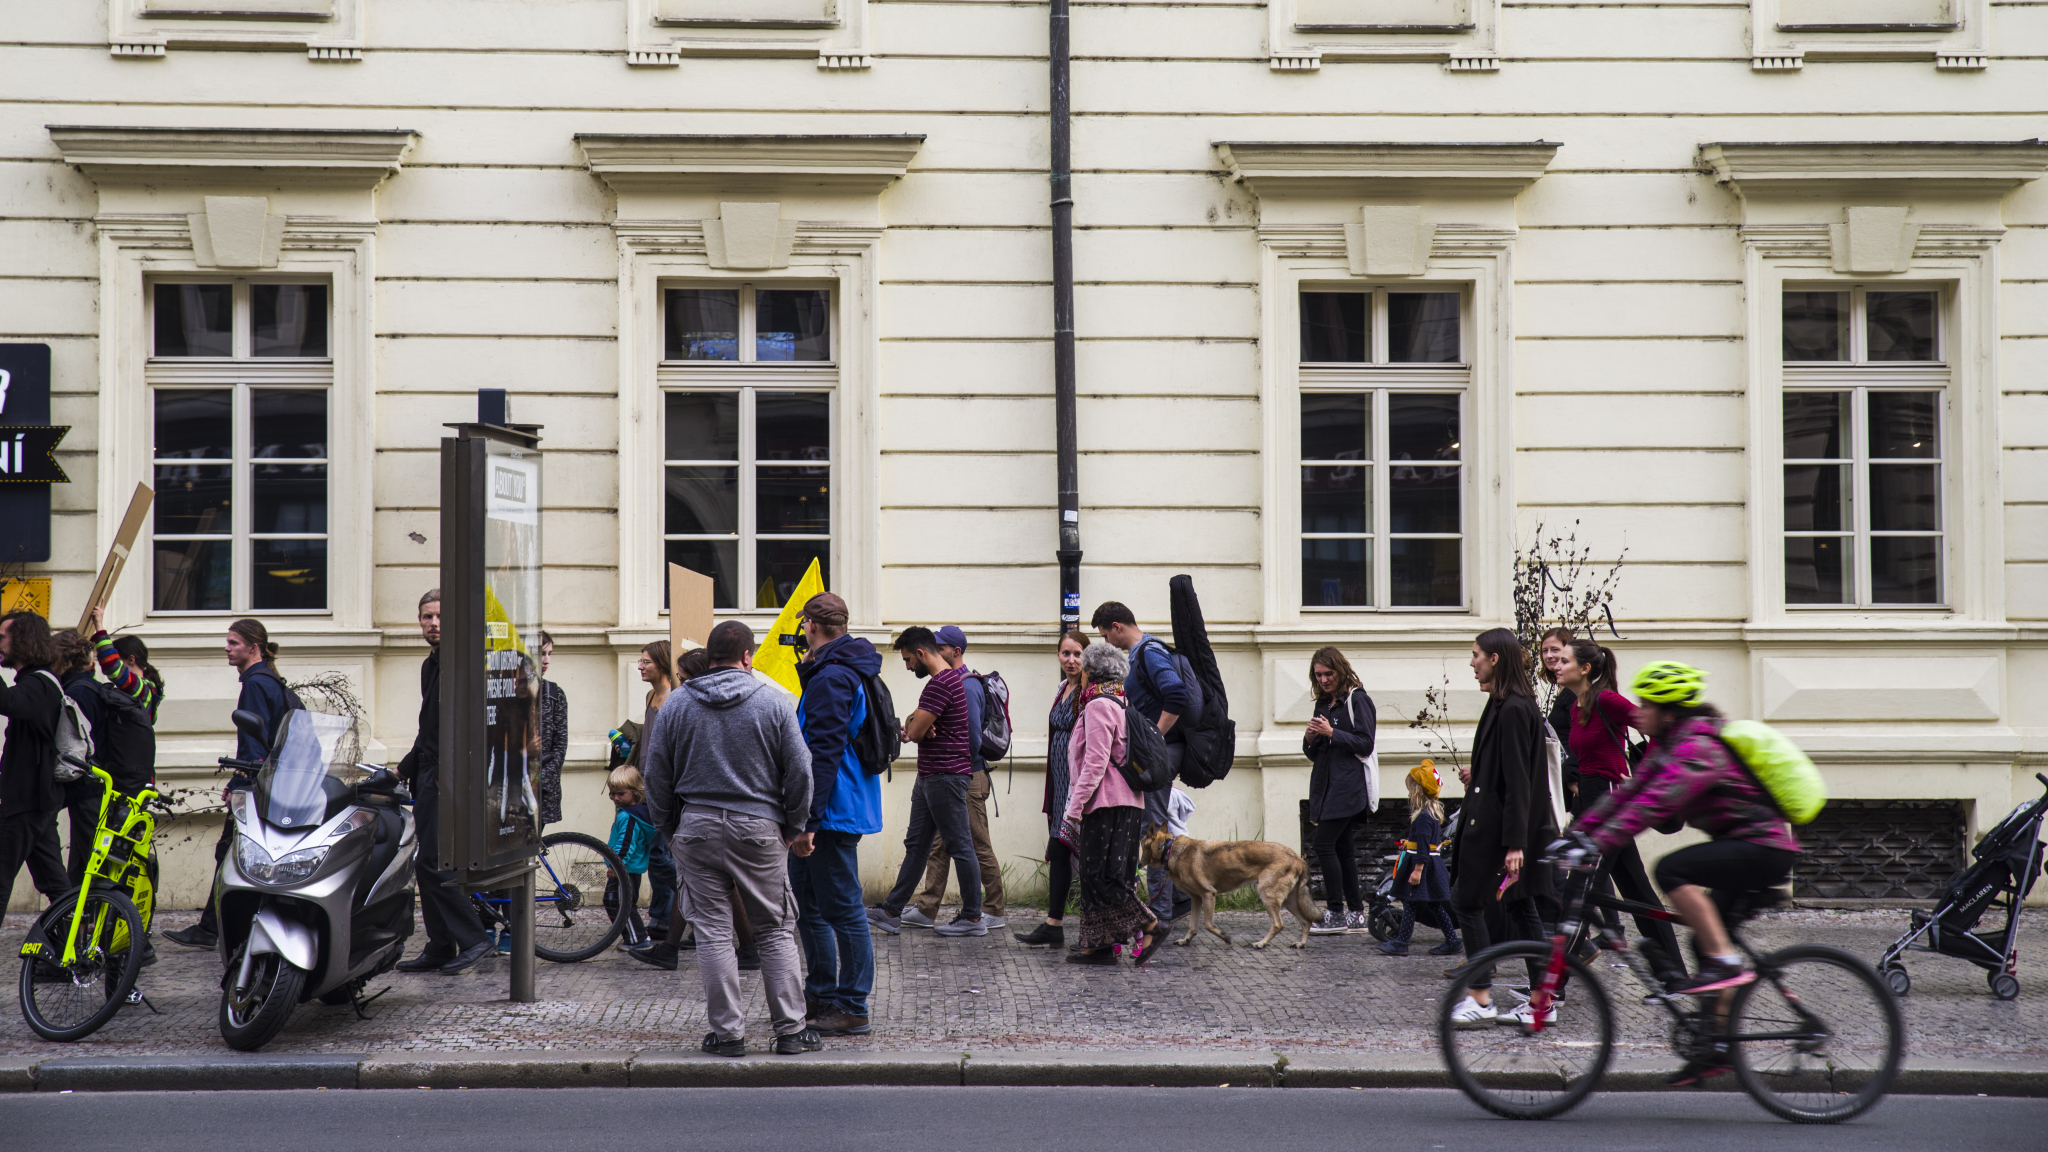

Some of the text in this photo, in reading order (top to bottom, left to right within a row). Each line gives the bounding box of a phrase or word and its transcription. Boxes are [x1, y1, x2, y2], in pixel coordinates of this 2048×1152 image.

[495, 470, 513, 497] ABOUT
[503, 678, 516, 698] PODLE
[487, 705, 497, 726] TEBE
[1959, 883, 1993, 913] MACLAREN
[21, 942, 43, 954] 0247
